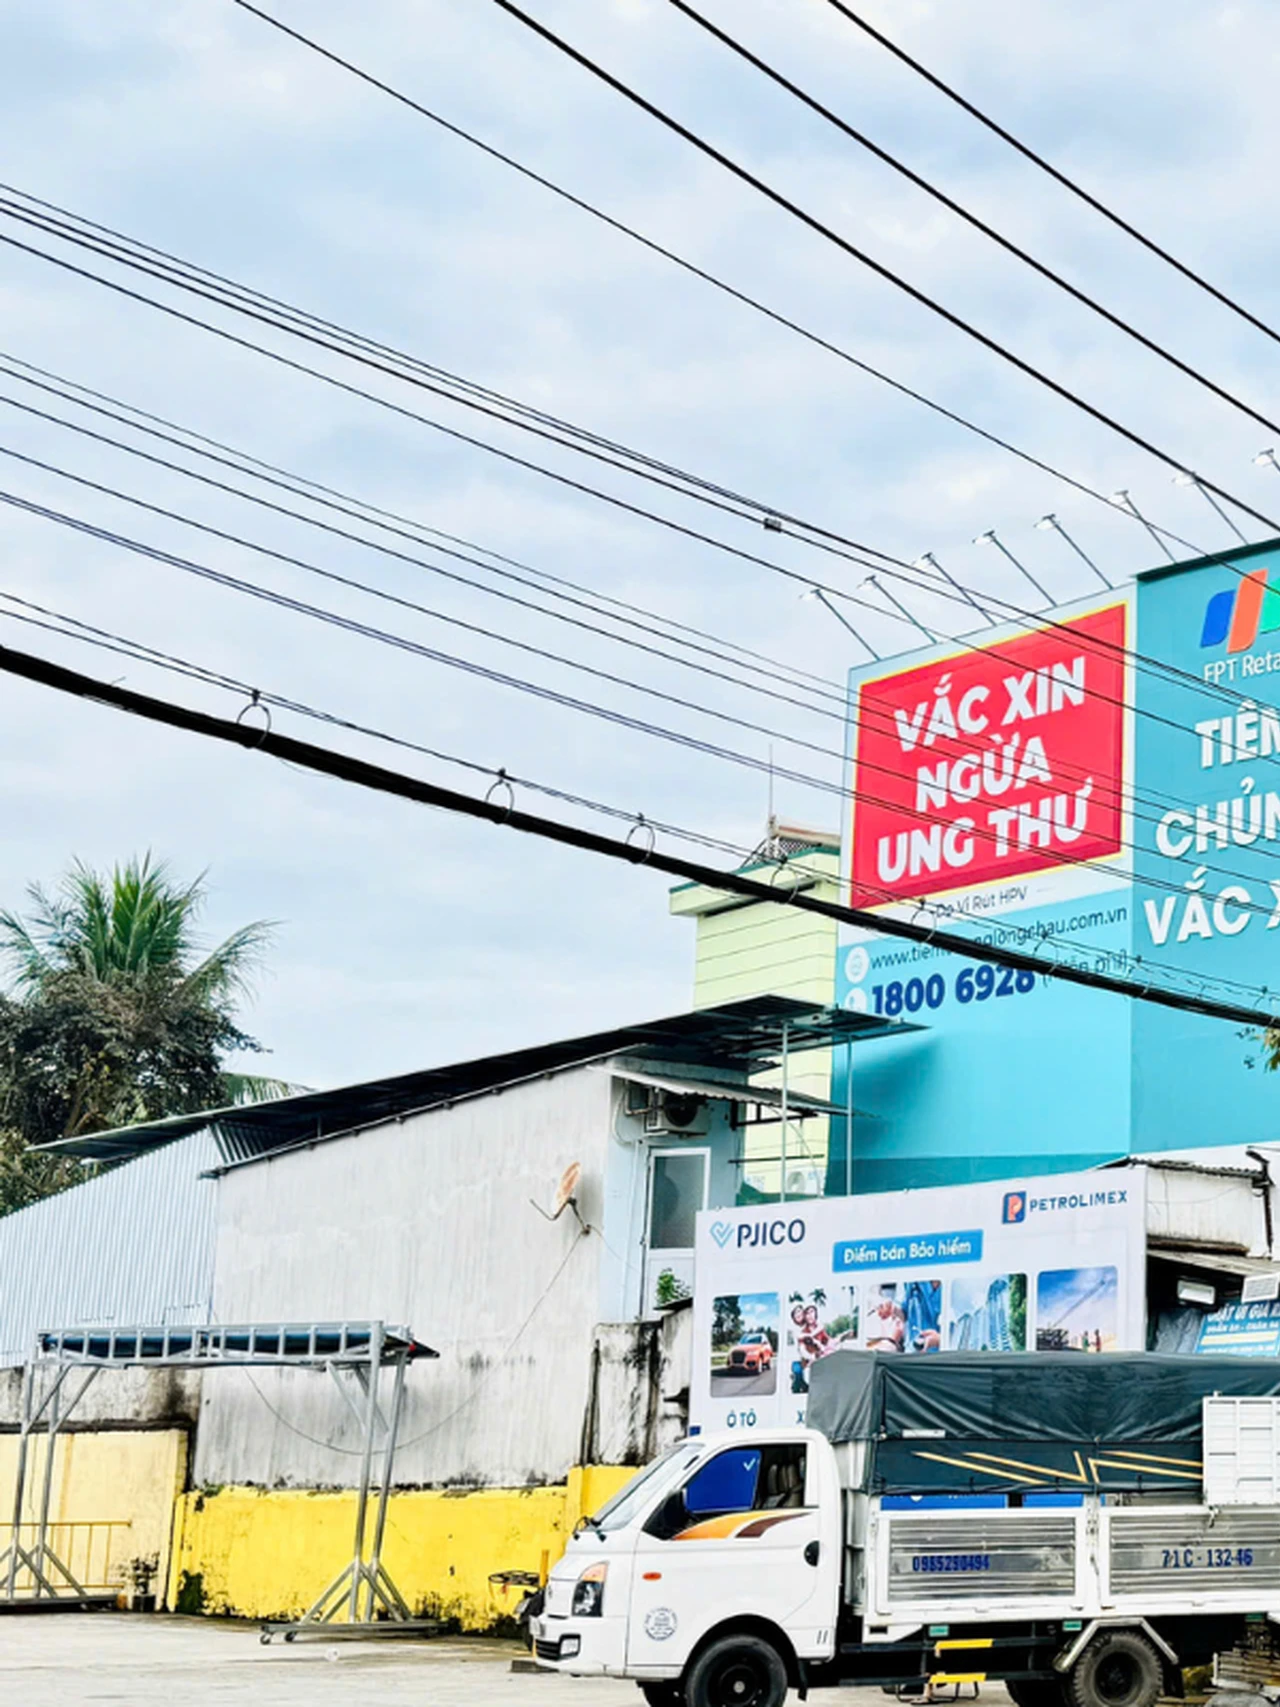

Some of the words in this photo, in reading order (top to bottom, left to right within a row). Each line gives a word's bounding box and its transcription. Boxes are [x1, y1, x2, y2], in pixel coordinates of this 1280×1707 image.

[1203, 657, 1237, 683] FPT
[894, 673, 989, 753] VẮC
[1001, 656, 1087, 725] XIN
[915, 731, 1053, 814] NGỪA
[876, 819, 975, 884] UNG
[987, 777, 1094, 857] THƯ
[998, 885, 1029, 905] HPV
[1143, 868, 1252, 947] VẮC
[872, 973, 946, 1017] 1800
[955, 963, 1036, 1004] 6928
[1029, 1190, 1128, 1213] PETROLIMEX
[737, 1219, 806, 1249] PJICO
[844, 1242, 877, 1265] Điểm
[880, 1241, 906, 1261] bán
[909, 1237, 935, 1259] Bảo
[939, 1238, 972, 1257] hiểm
[727, 1409, 736, 1428] Ô
[739, 1408, 757, 1427] TÔ
